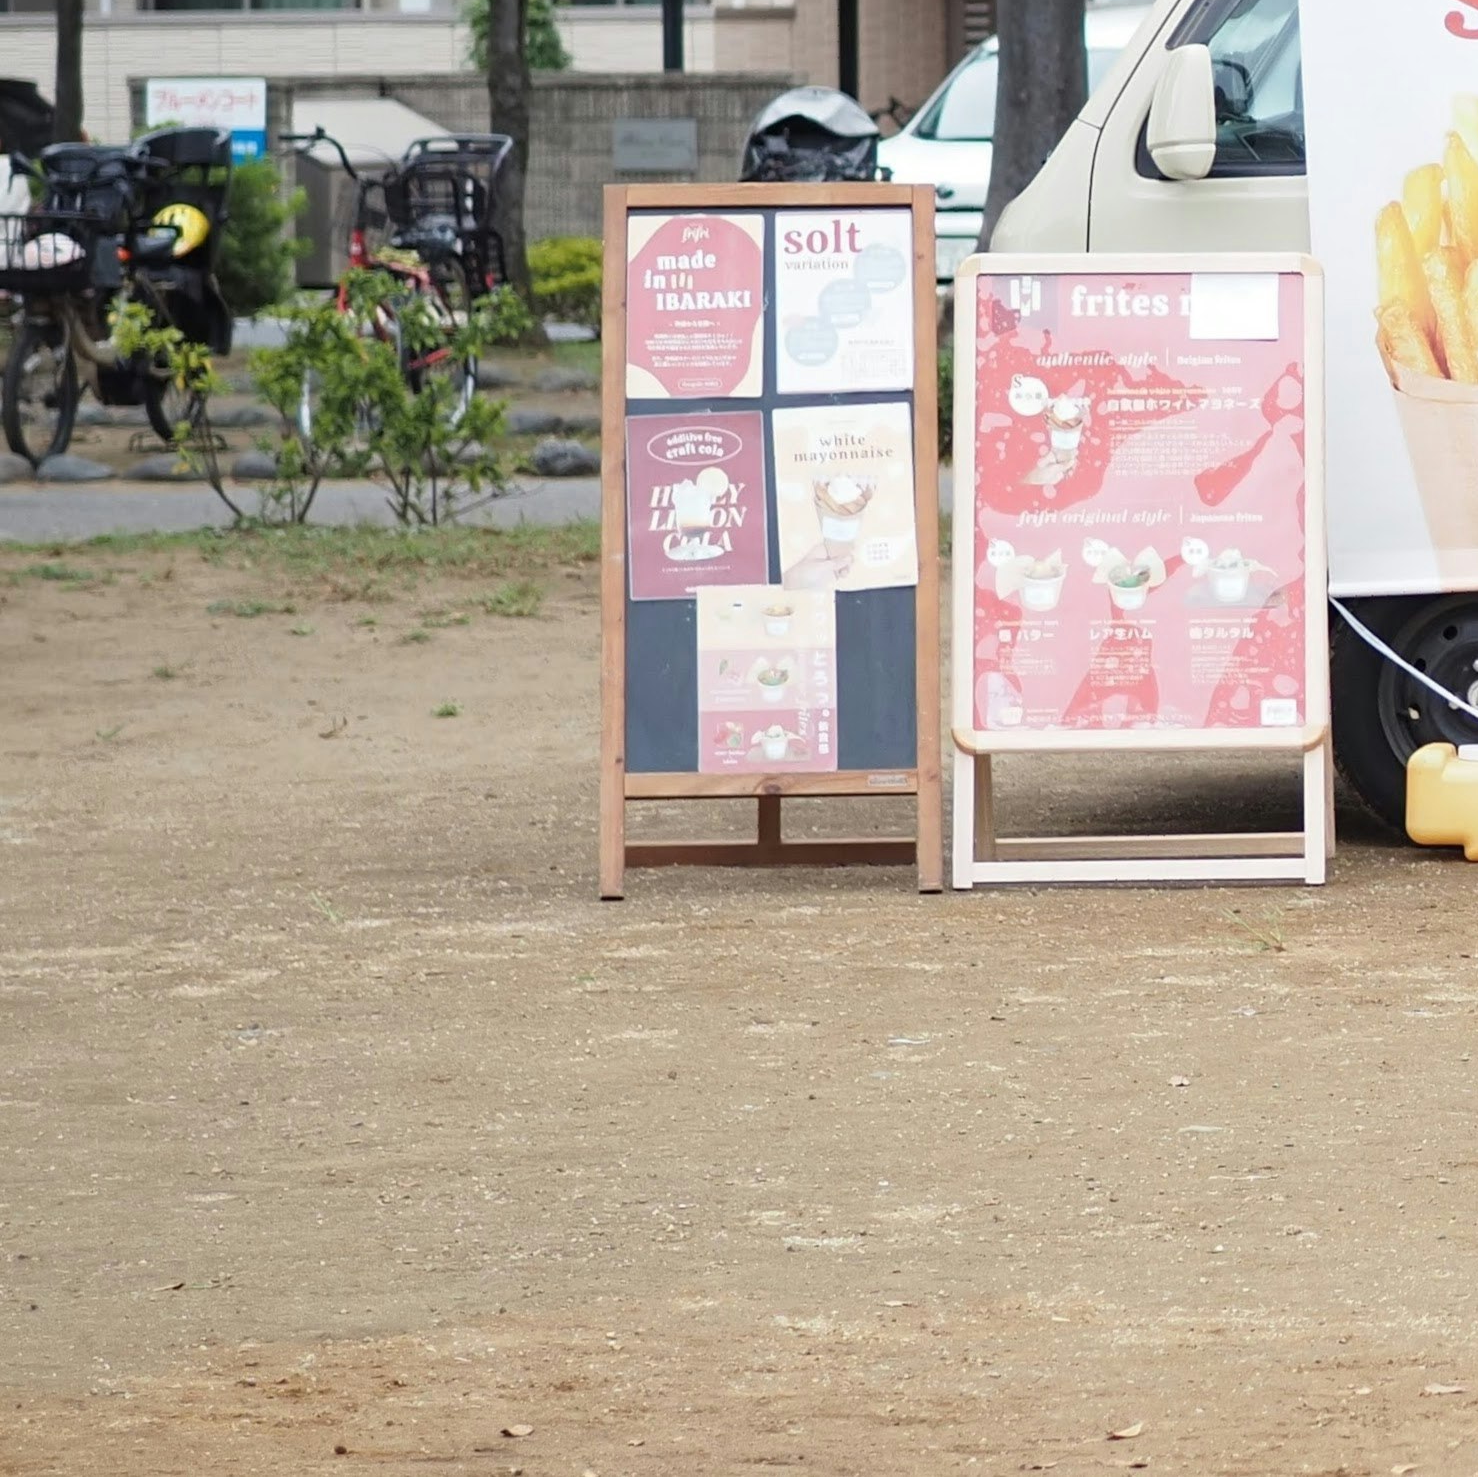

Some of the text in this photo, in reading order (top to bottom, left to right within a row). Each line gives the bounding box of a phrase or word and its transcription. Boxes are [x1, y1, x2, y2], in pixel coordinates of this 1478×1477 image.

[783, 219, 863, 255] solt
[656, 249, 717, 270] made
[784, 258, 849, 271] variation
[656, 290, 751, 311] IBARAKI
[1070, 284, 1170, 317] frites
[1036, 348, 1115, 367] authentic
[1119, 350, 1158, 368] style
[704, 432, 723, 444] free
[819, 433, 866, 447] white
[666, 443, 724, 459] craft cola
[793, 446, 894, 464] mayonnaise
[1062, 509, 1128, 525] original
[1132, 509, 1171, 527] style
